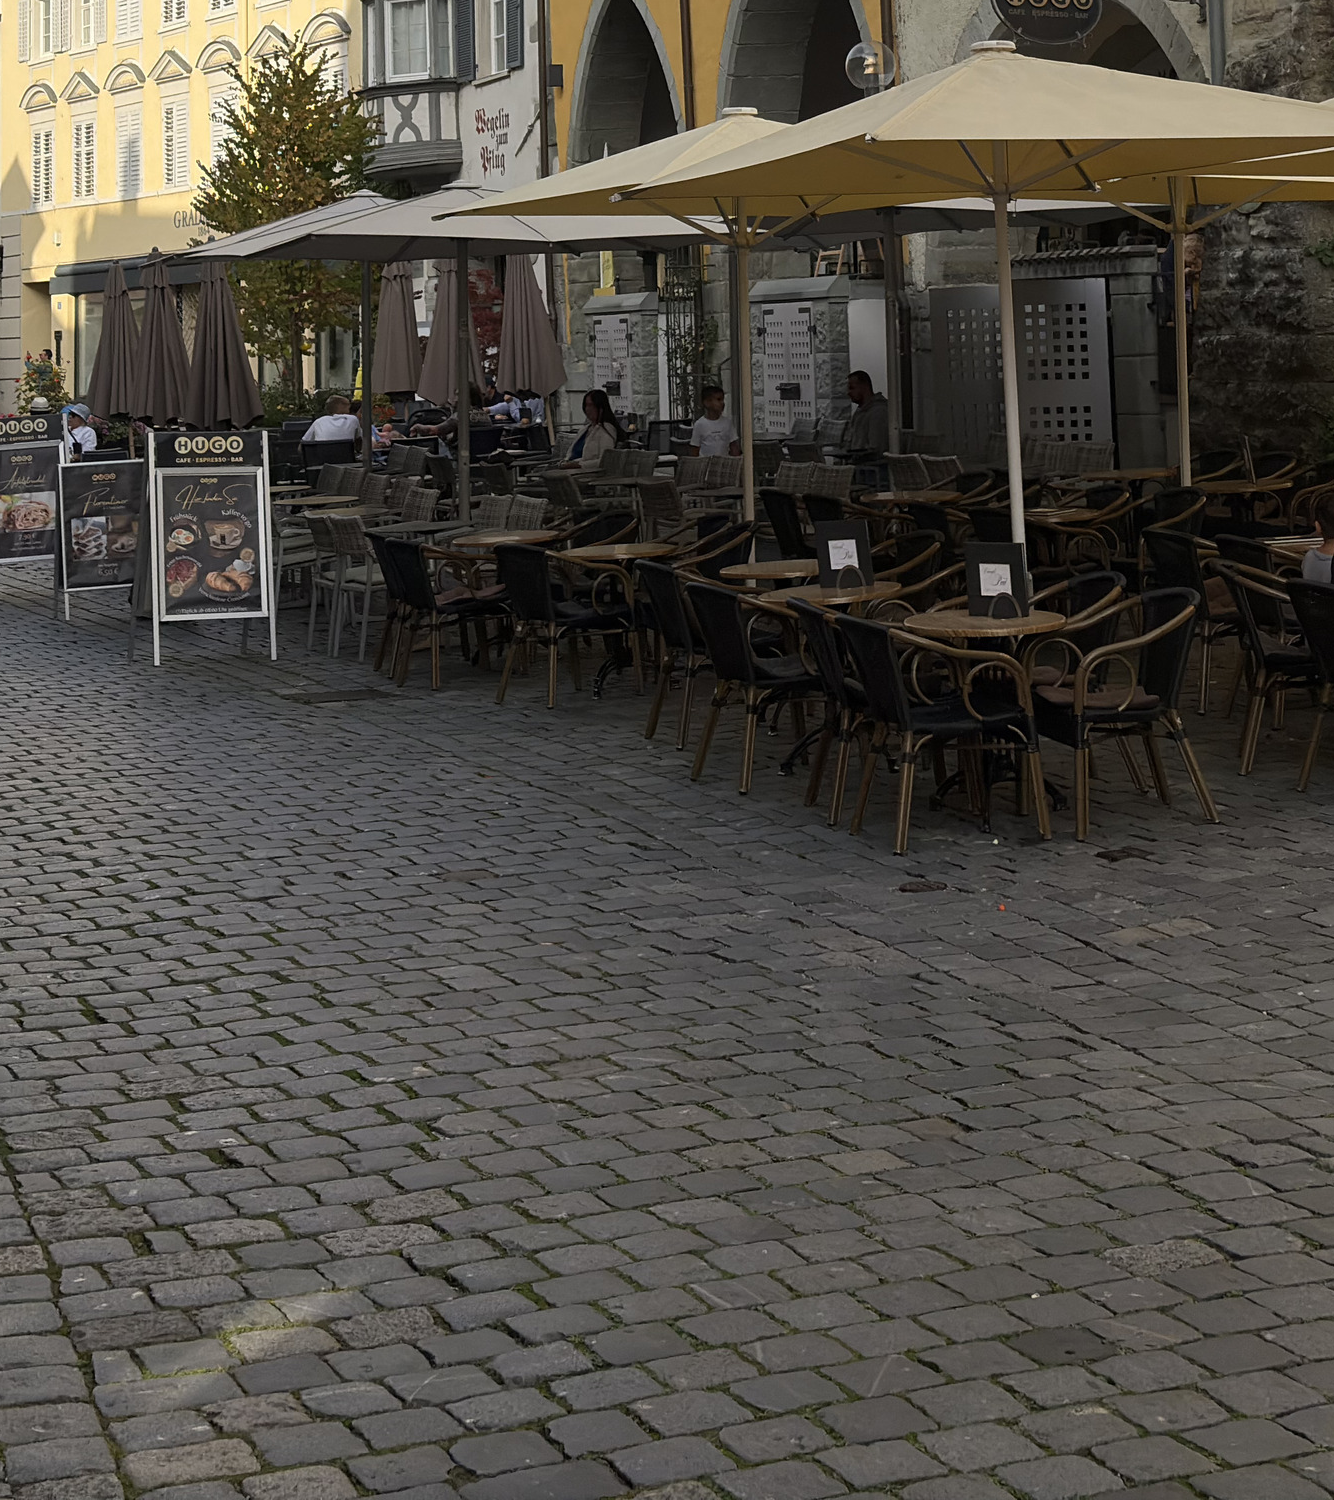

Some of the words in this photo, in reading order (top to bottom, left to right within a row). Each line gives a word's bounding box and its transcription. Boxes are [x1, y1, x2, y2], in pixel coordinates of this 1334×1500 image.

[475, 108, 510, 139] Wegelin
[496, 132, 509, 151] zum
[480, 146, 506, 180] Pflug
[176, 437, 243, 453] HUGO
[221, 508, 241, 518] Kaffee
